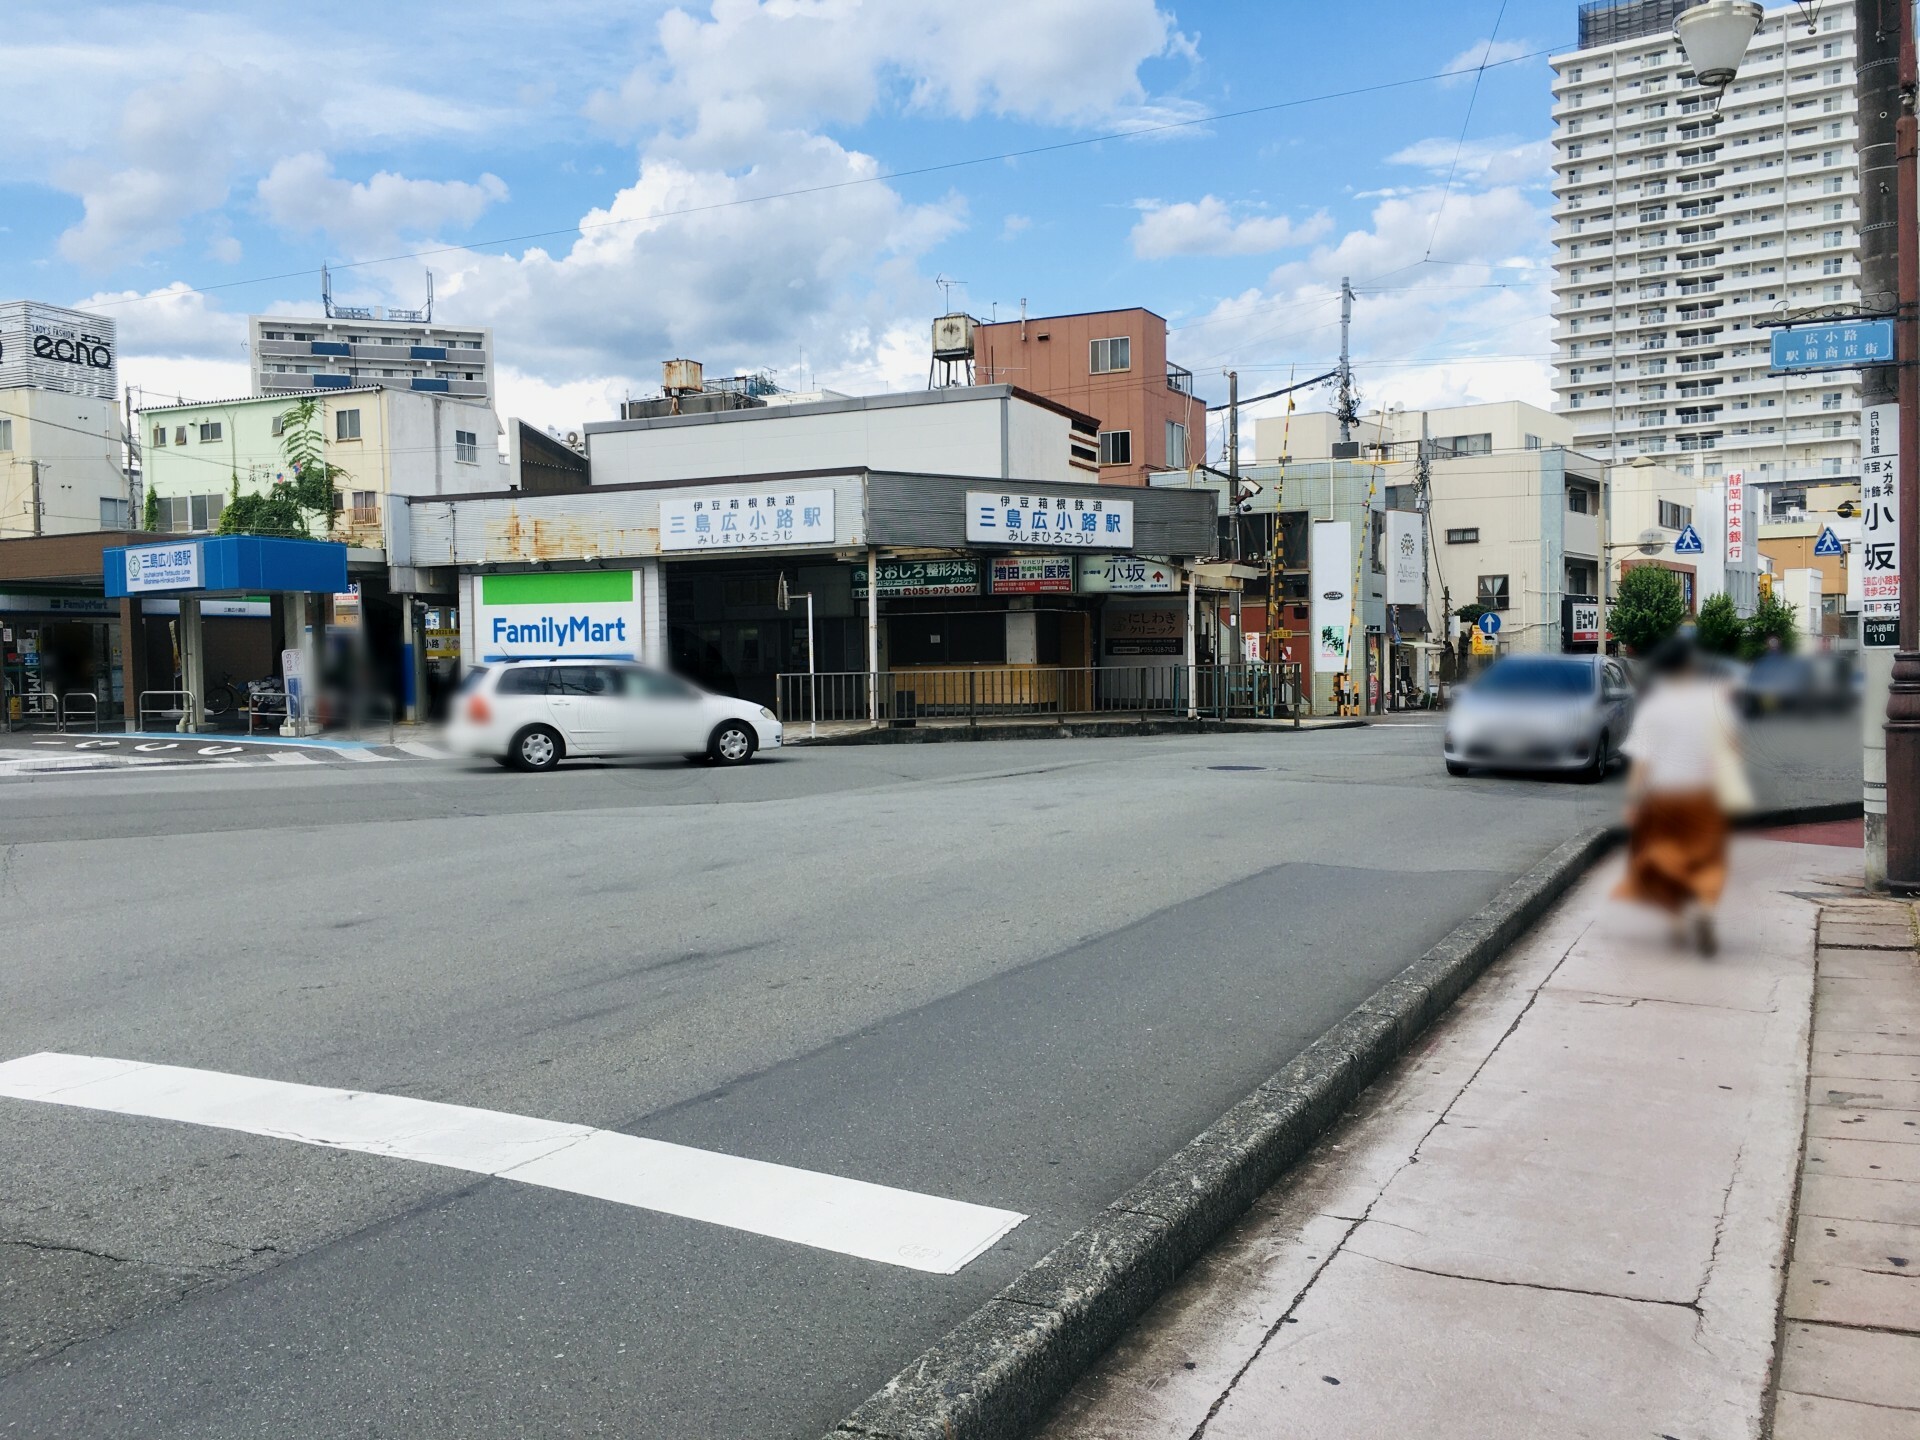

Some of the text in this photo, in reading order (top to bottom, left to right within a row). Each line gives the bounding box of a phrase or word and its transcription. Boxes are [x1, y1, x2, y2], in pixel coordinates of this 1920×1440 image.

[53, 328, 76, 340] FASHION
[1805, 329, 1858, 346] 広小路
[1785, 342, 1878, 362] 駅前商店街
[1870, 411, 1880, 454] 白い時計塔
[1871, 461, 1881, 498] 宝飾
[1883, 460, 1894, 496] メガネ
[694, 495, 796, 512] 伊豆箱根鉄道
[1000, 496, 1103, 512] 伊豆箱根鉄道
[670, 506, 821, 534] 三島広小路駅
[980, 507, 1121, 533] 三島広小路駅
[1728, 473, 1742, 558] 静岡中央銀行
[697, 530, 793, 545] みしまひろこうじ
[1008, 529, 1095, 544] みしまひろこうじ
[1864, 503, 1896, 571] 小坂
[142, 549, 192, 569] 三島広小路駅
[994, 566, 1020, 580] 増田
[1044, 564, 1070, 579] 医院
[1104, 563, 1146, 583] 小坂
[912, 586, 977, 595] 055-976-0027
[1864, 585, 1898, 597] 徒歩2分
[493, 616, 626, 647] FamilyMart
[1866, 623, 1896, 633] 広小路町
[1873, 633, 1886, 642] 10
